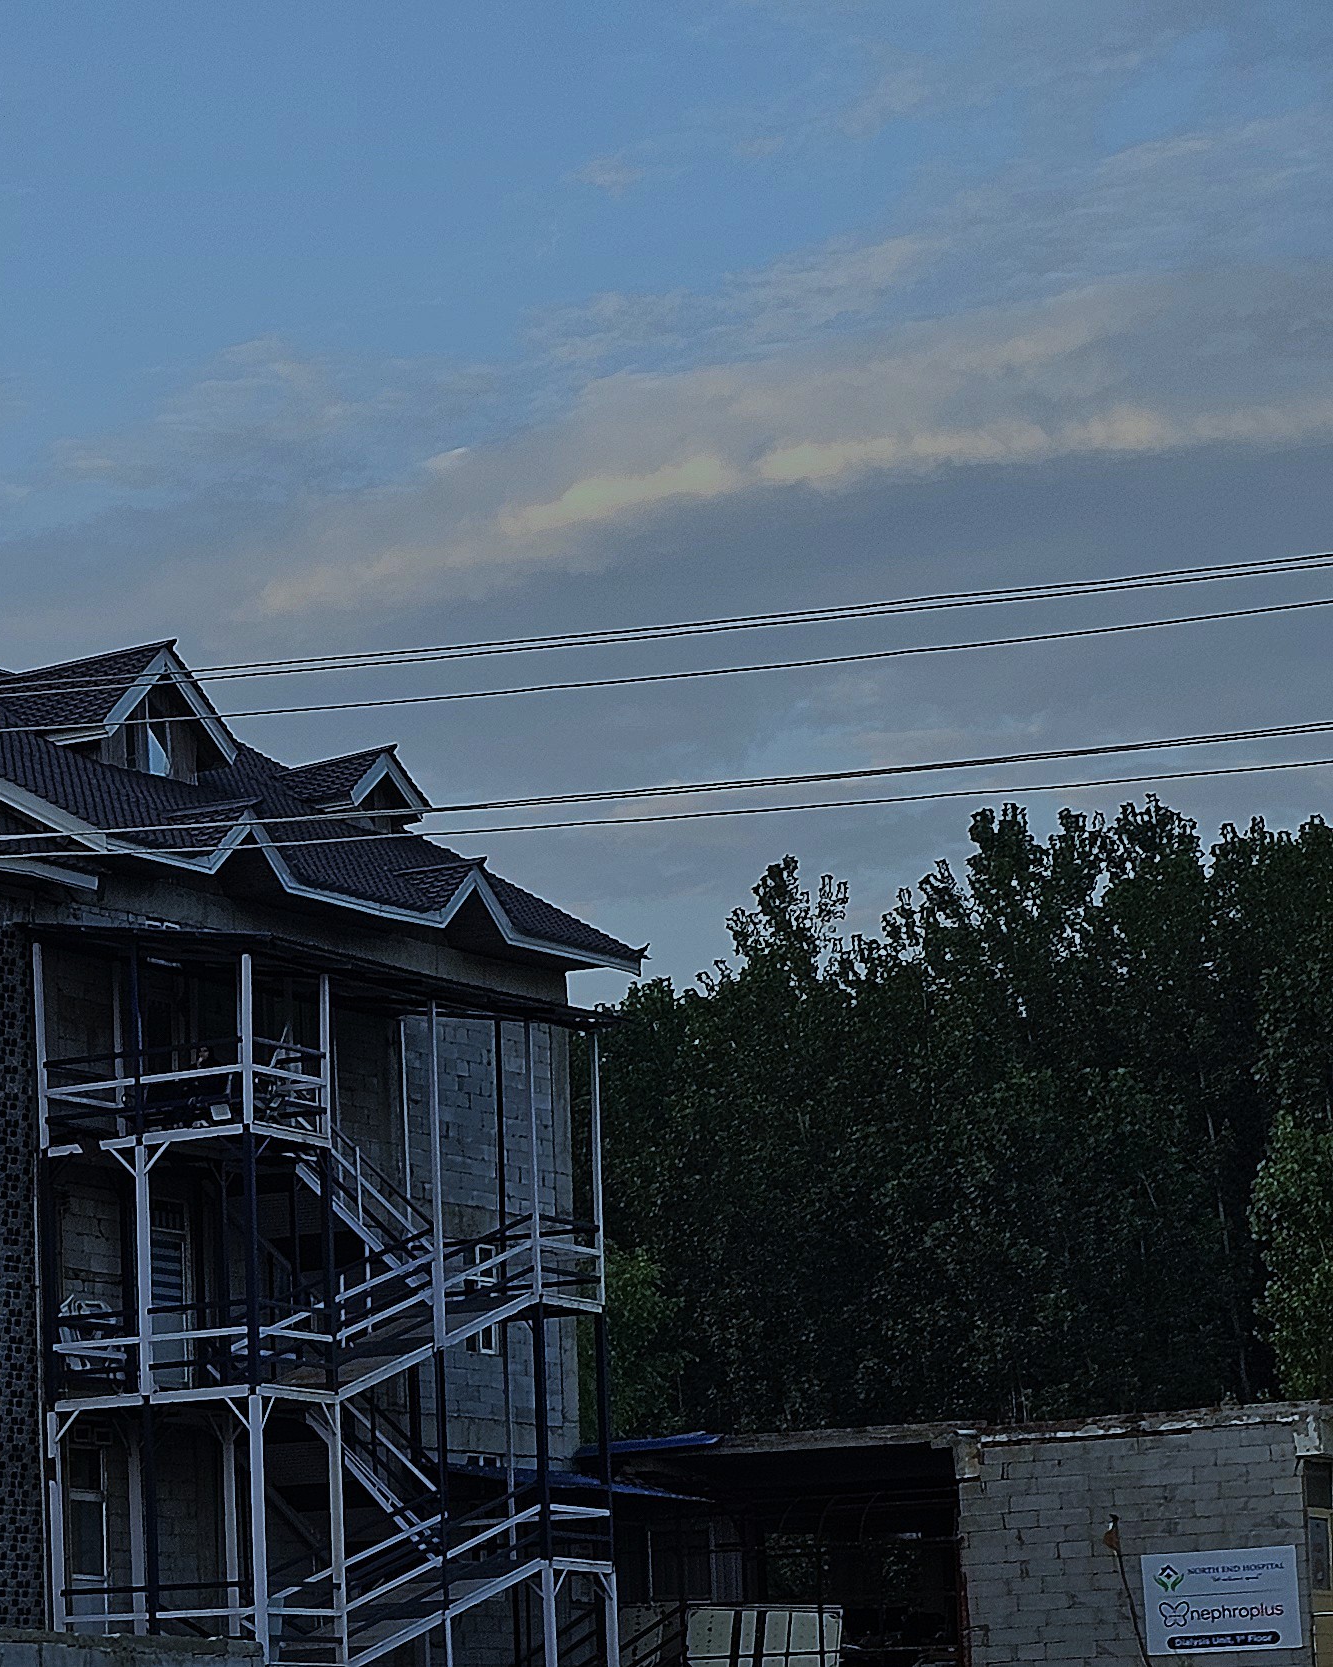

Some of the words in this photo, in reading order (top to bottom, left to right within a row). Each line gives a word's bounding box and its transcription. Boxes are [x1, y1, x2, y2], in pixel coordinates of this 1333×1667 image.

[1187, 1567, 1220, 1575] NORTH
[1242, 1562, 1284, 1571] HOSPITAL
[1190, 1602, 1284, 1623] nephroplus
[1174, 1638, 1210, 1646] Dialysis
[1212, 1636, 1234, 1644] Unit,
[1247, 1634, 1272, 1642] Floor
